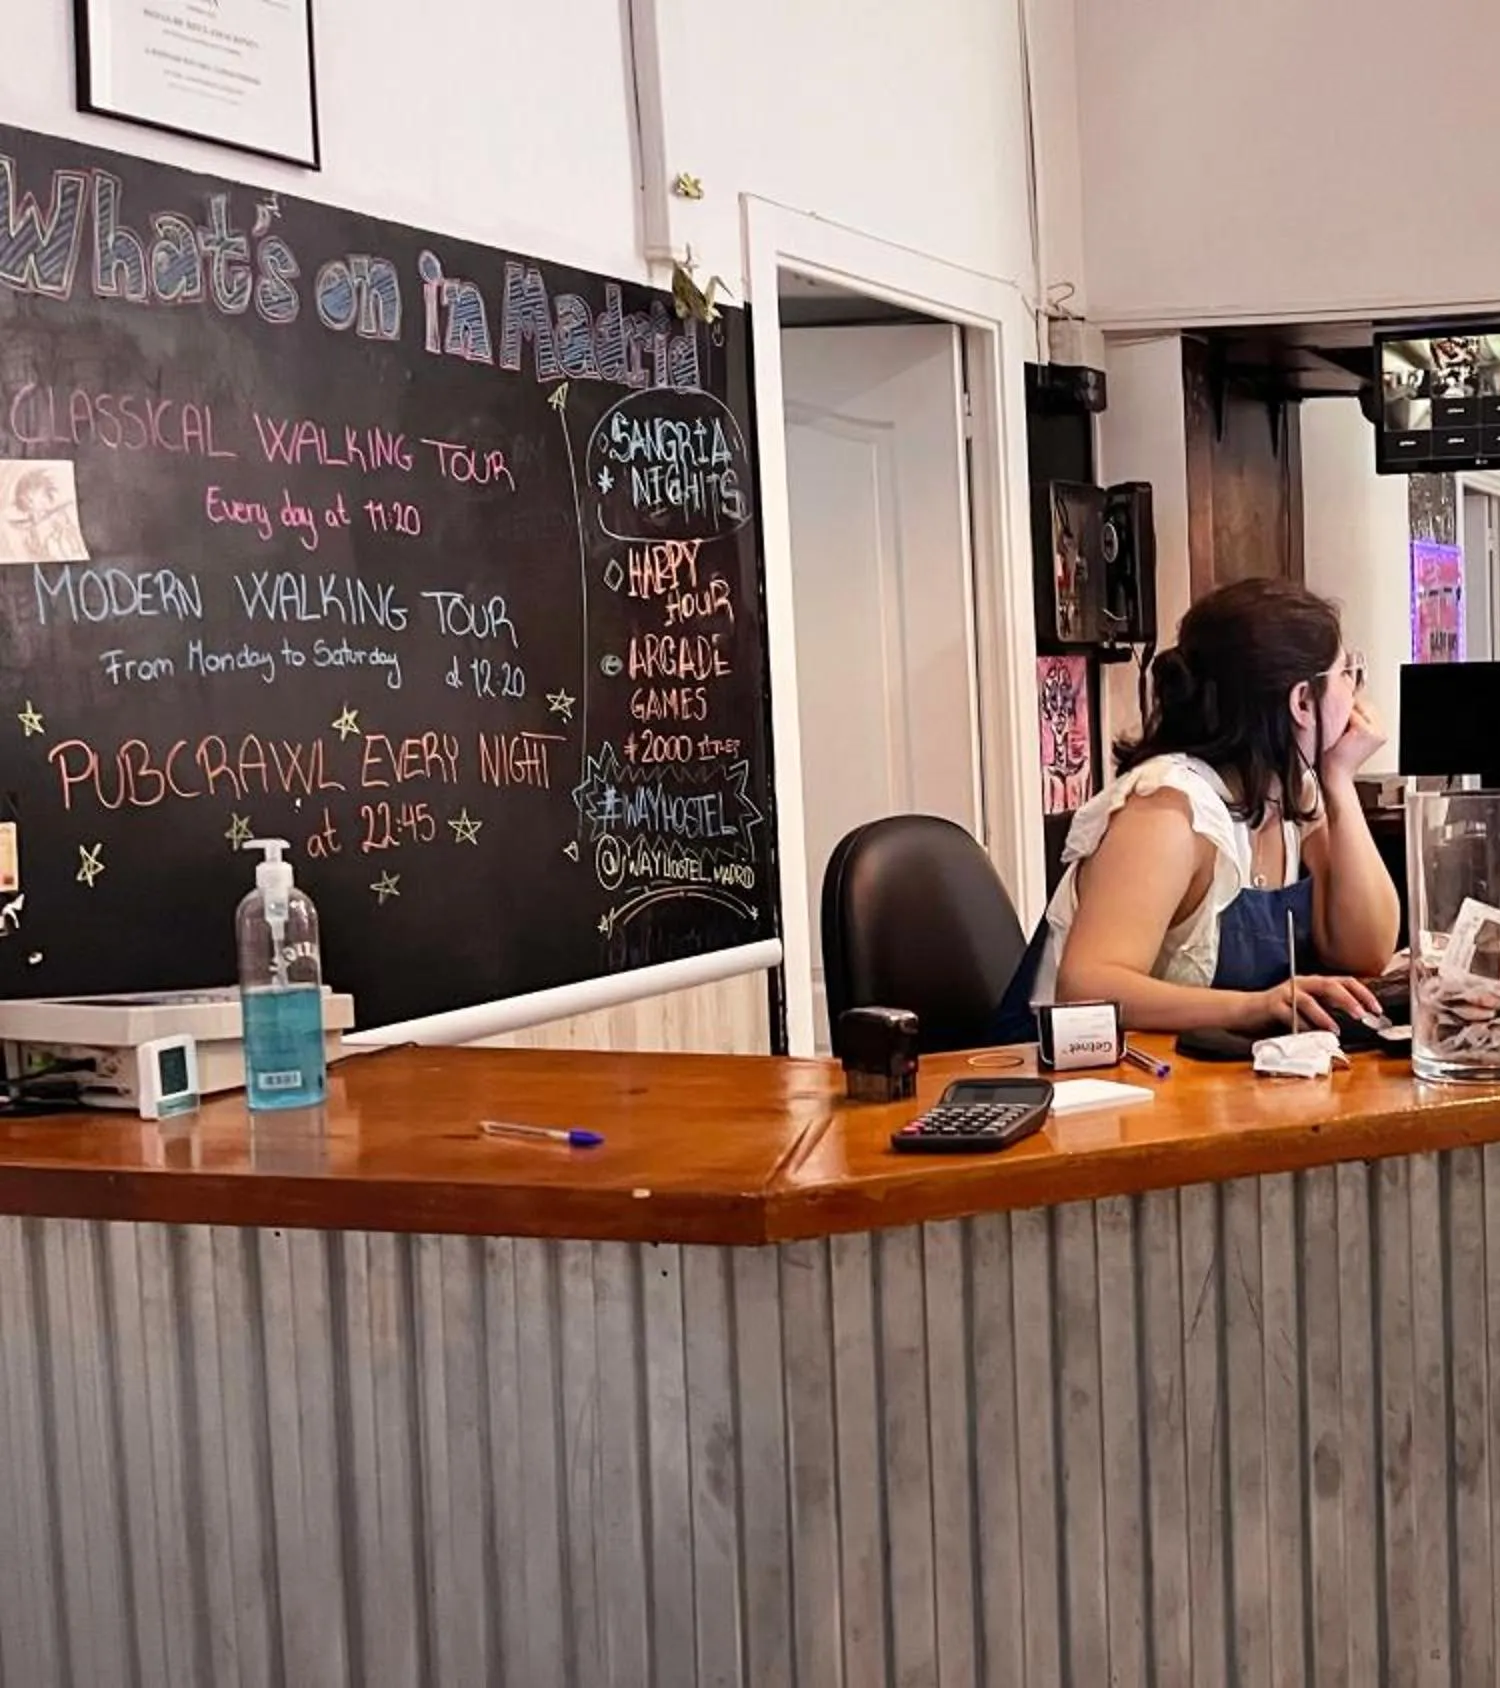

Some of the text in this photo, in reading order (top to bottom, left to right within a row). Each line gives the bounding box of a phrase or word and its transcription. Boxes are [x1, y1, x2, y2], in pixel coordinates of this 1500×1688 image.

[0, 154, 702, 392] What's on in Madrid
[10, 383, 516, 492] CLASSICAL WALKING TOUR
[608, 410, 733, 467] SANGRIA
[206, 486, 421, 551] Every day at 11:20
[631, 462, 747, 524] NIGHTS
[628, 539, 700, 599] HAPPY
[33, 563, 519, 650] MODERN WALKING TOUR
[664, 579, 734, 627] HOUR
[100, 650, 175, 686] From
[188, 639, 276, 684] Monday
[281, 637, 306, 668] to
[313, 637, 402, 690] Saturday
[470, 657, 526, 698] 12:20
[628, 633, 733, 682] ARCADE
[631, 687, 708, 720] GAMES
[361, 733, 460, 787] EVERY
[478, 730, 567, 791] NIGHT
[306, 800, 437, 858] at 22:45
